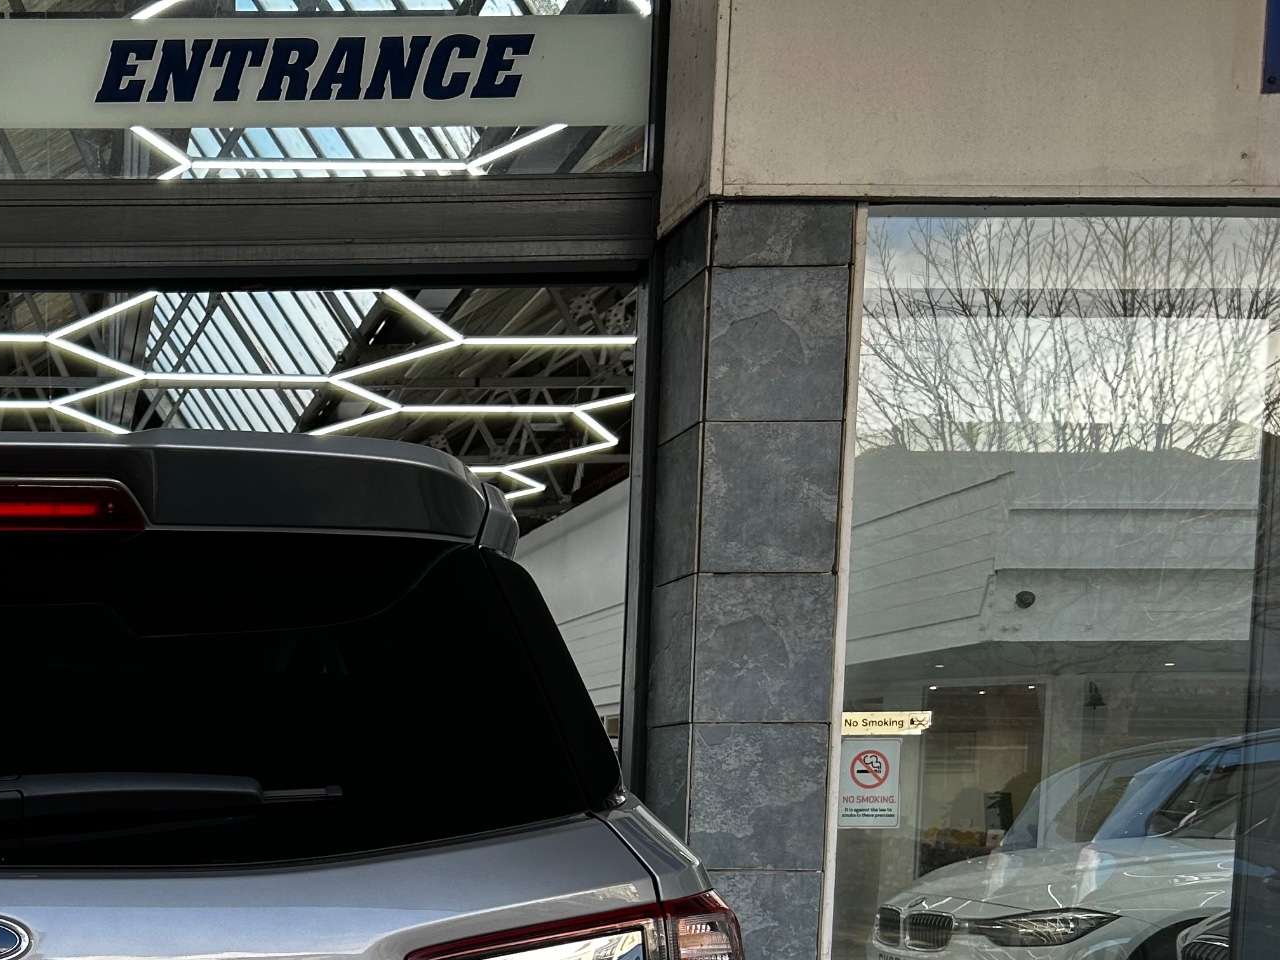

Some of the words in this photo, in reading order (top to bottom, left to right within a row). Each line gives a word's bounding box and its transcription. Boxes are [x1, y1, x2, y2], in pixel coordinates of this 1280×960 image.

[94, 33, 536, 103] ENTRANCE
[844, 719, 858, 727] No
[862, 719, 904, 728] Smoking
[842, 795, 855, 804] NO
